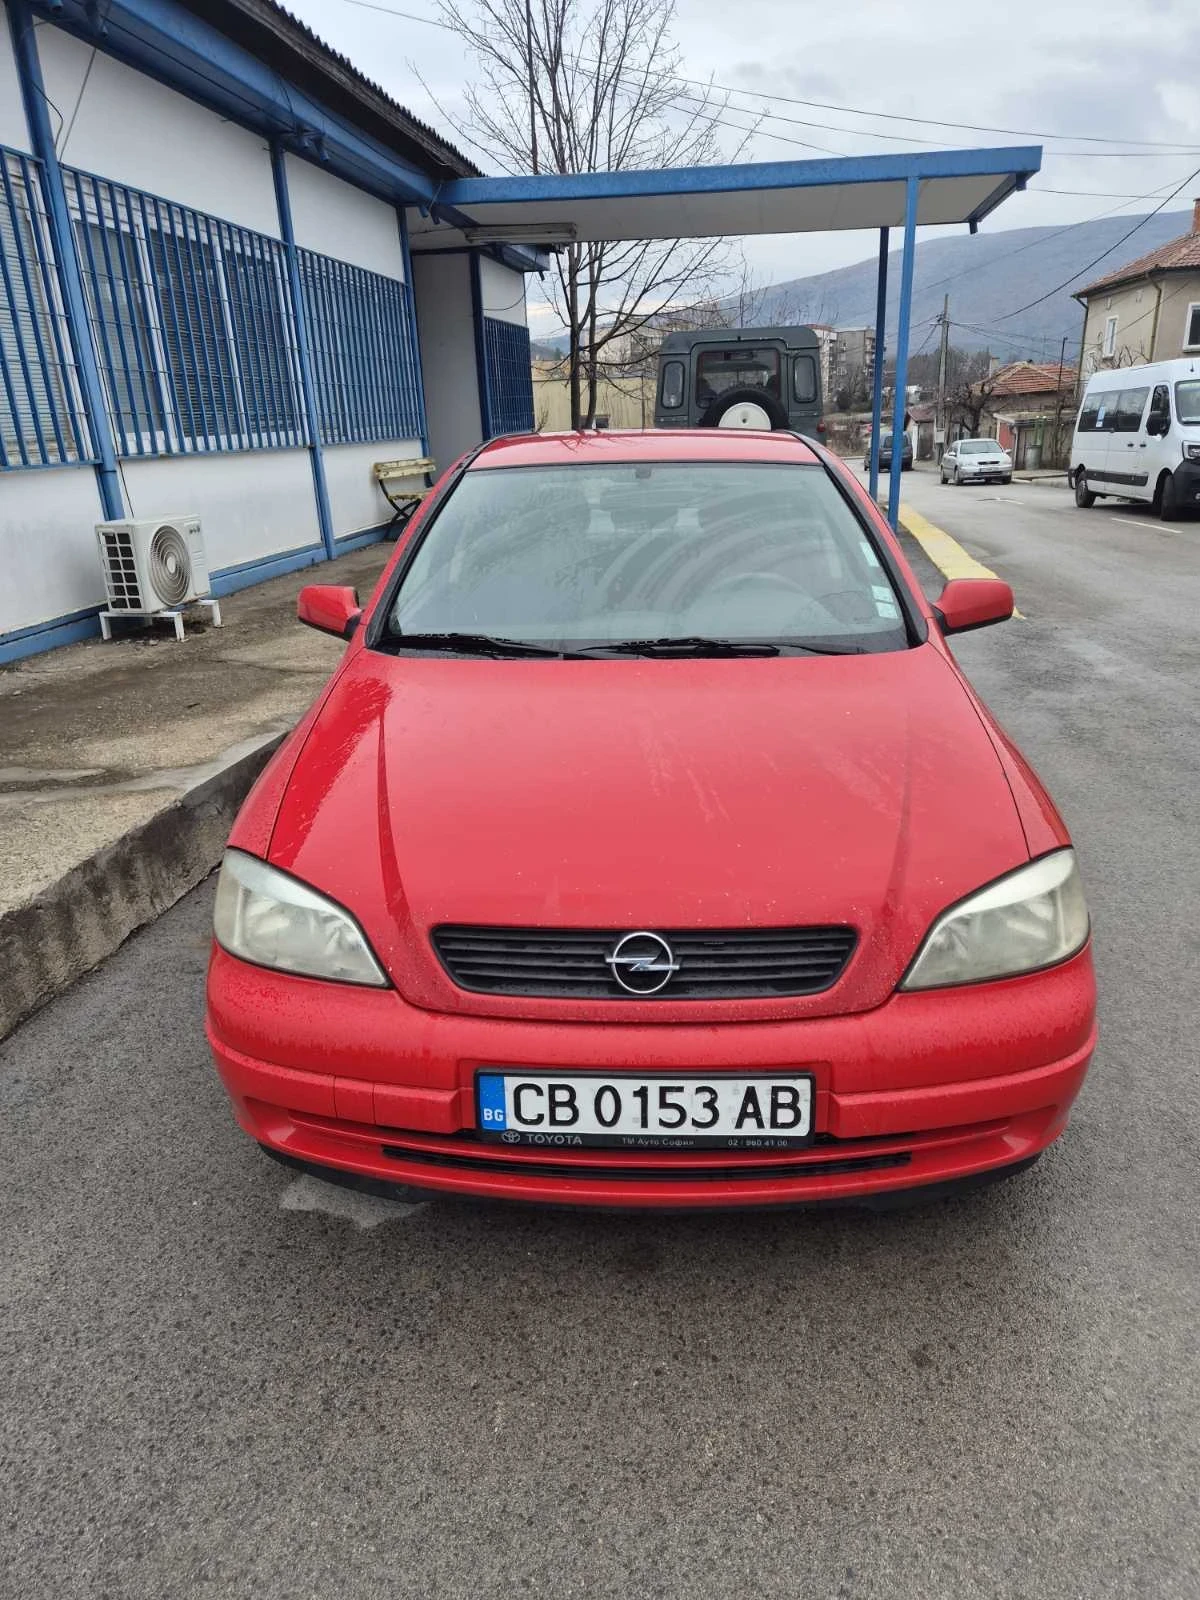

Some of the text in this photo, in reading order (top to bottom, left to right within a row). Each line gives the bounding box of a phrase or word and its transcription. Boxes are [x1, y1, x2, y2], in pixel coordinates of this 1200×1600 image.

[513, 1083, 802, 1129] CB 0153 AB
[484, 1108, 504, 1121] BG
[525, 1134, 583, 1145] TOYOTA
